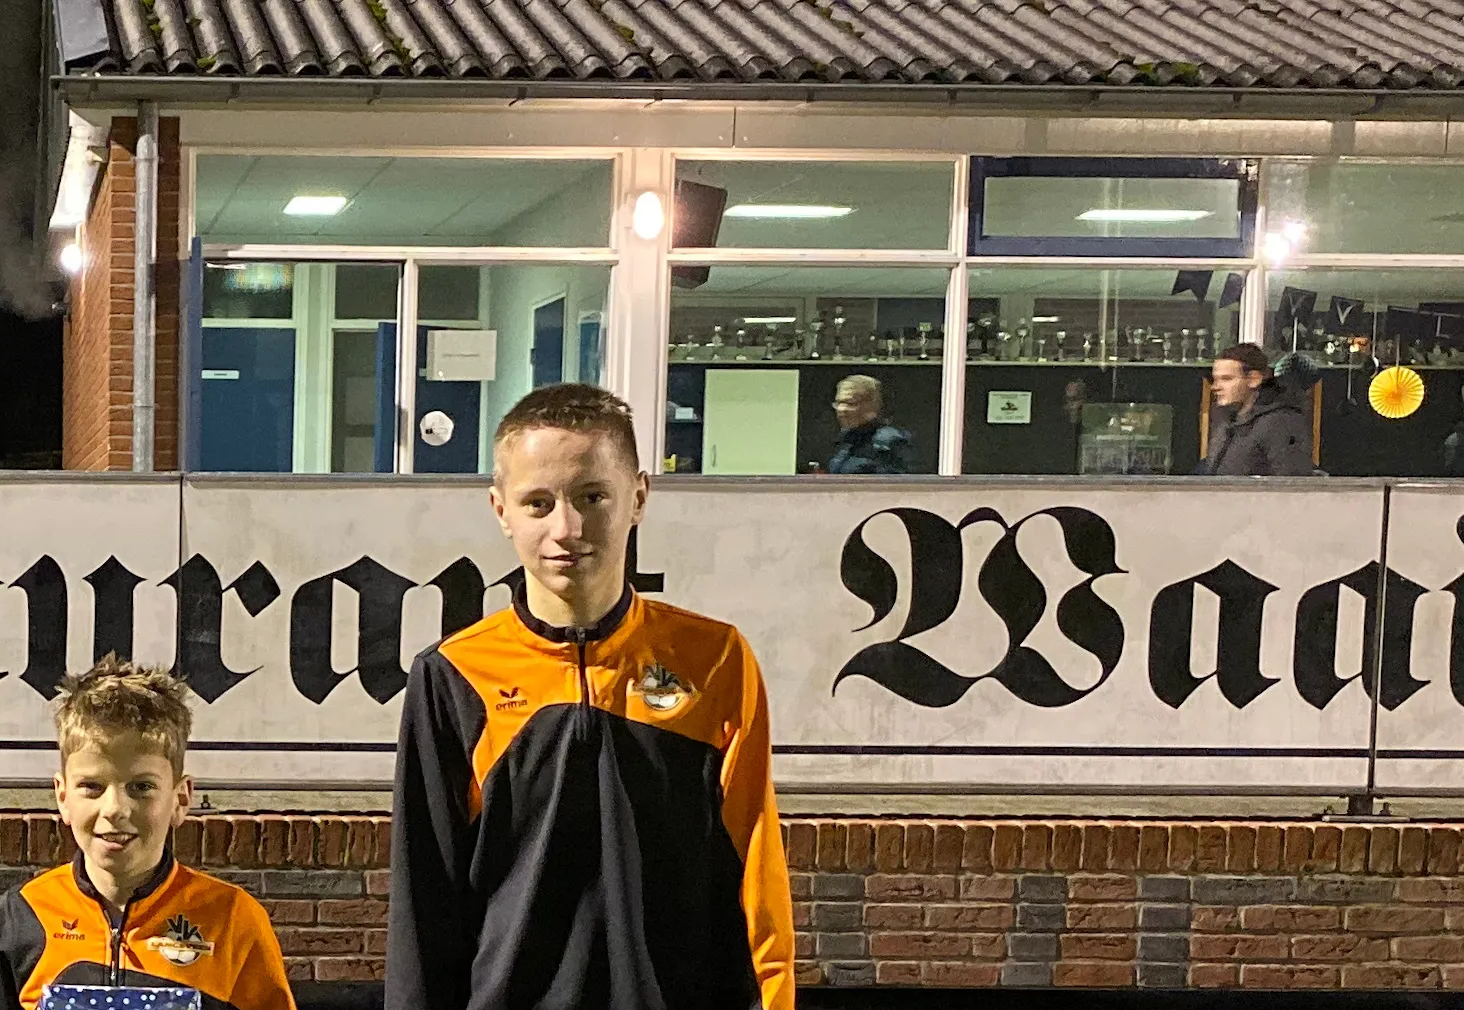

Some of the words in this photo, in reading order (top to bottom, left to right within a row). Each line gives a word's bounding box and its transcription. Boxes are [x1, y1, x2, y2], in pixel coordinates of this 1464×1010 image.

[833, 505, 1464, 711] Waa
[496, 698, 528, 712] erima
[53, 931, 86, 941] erima
